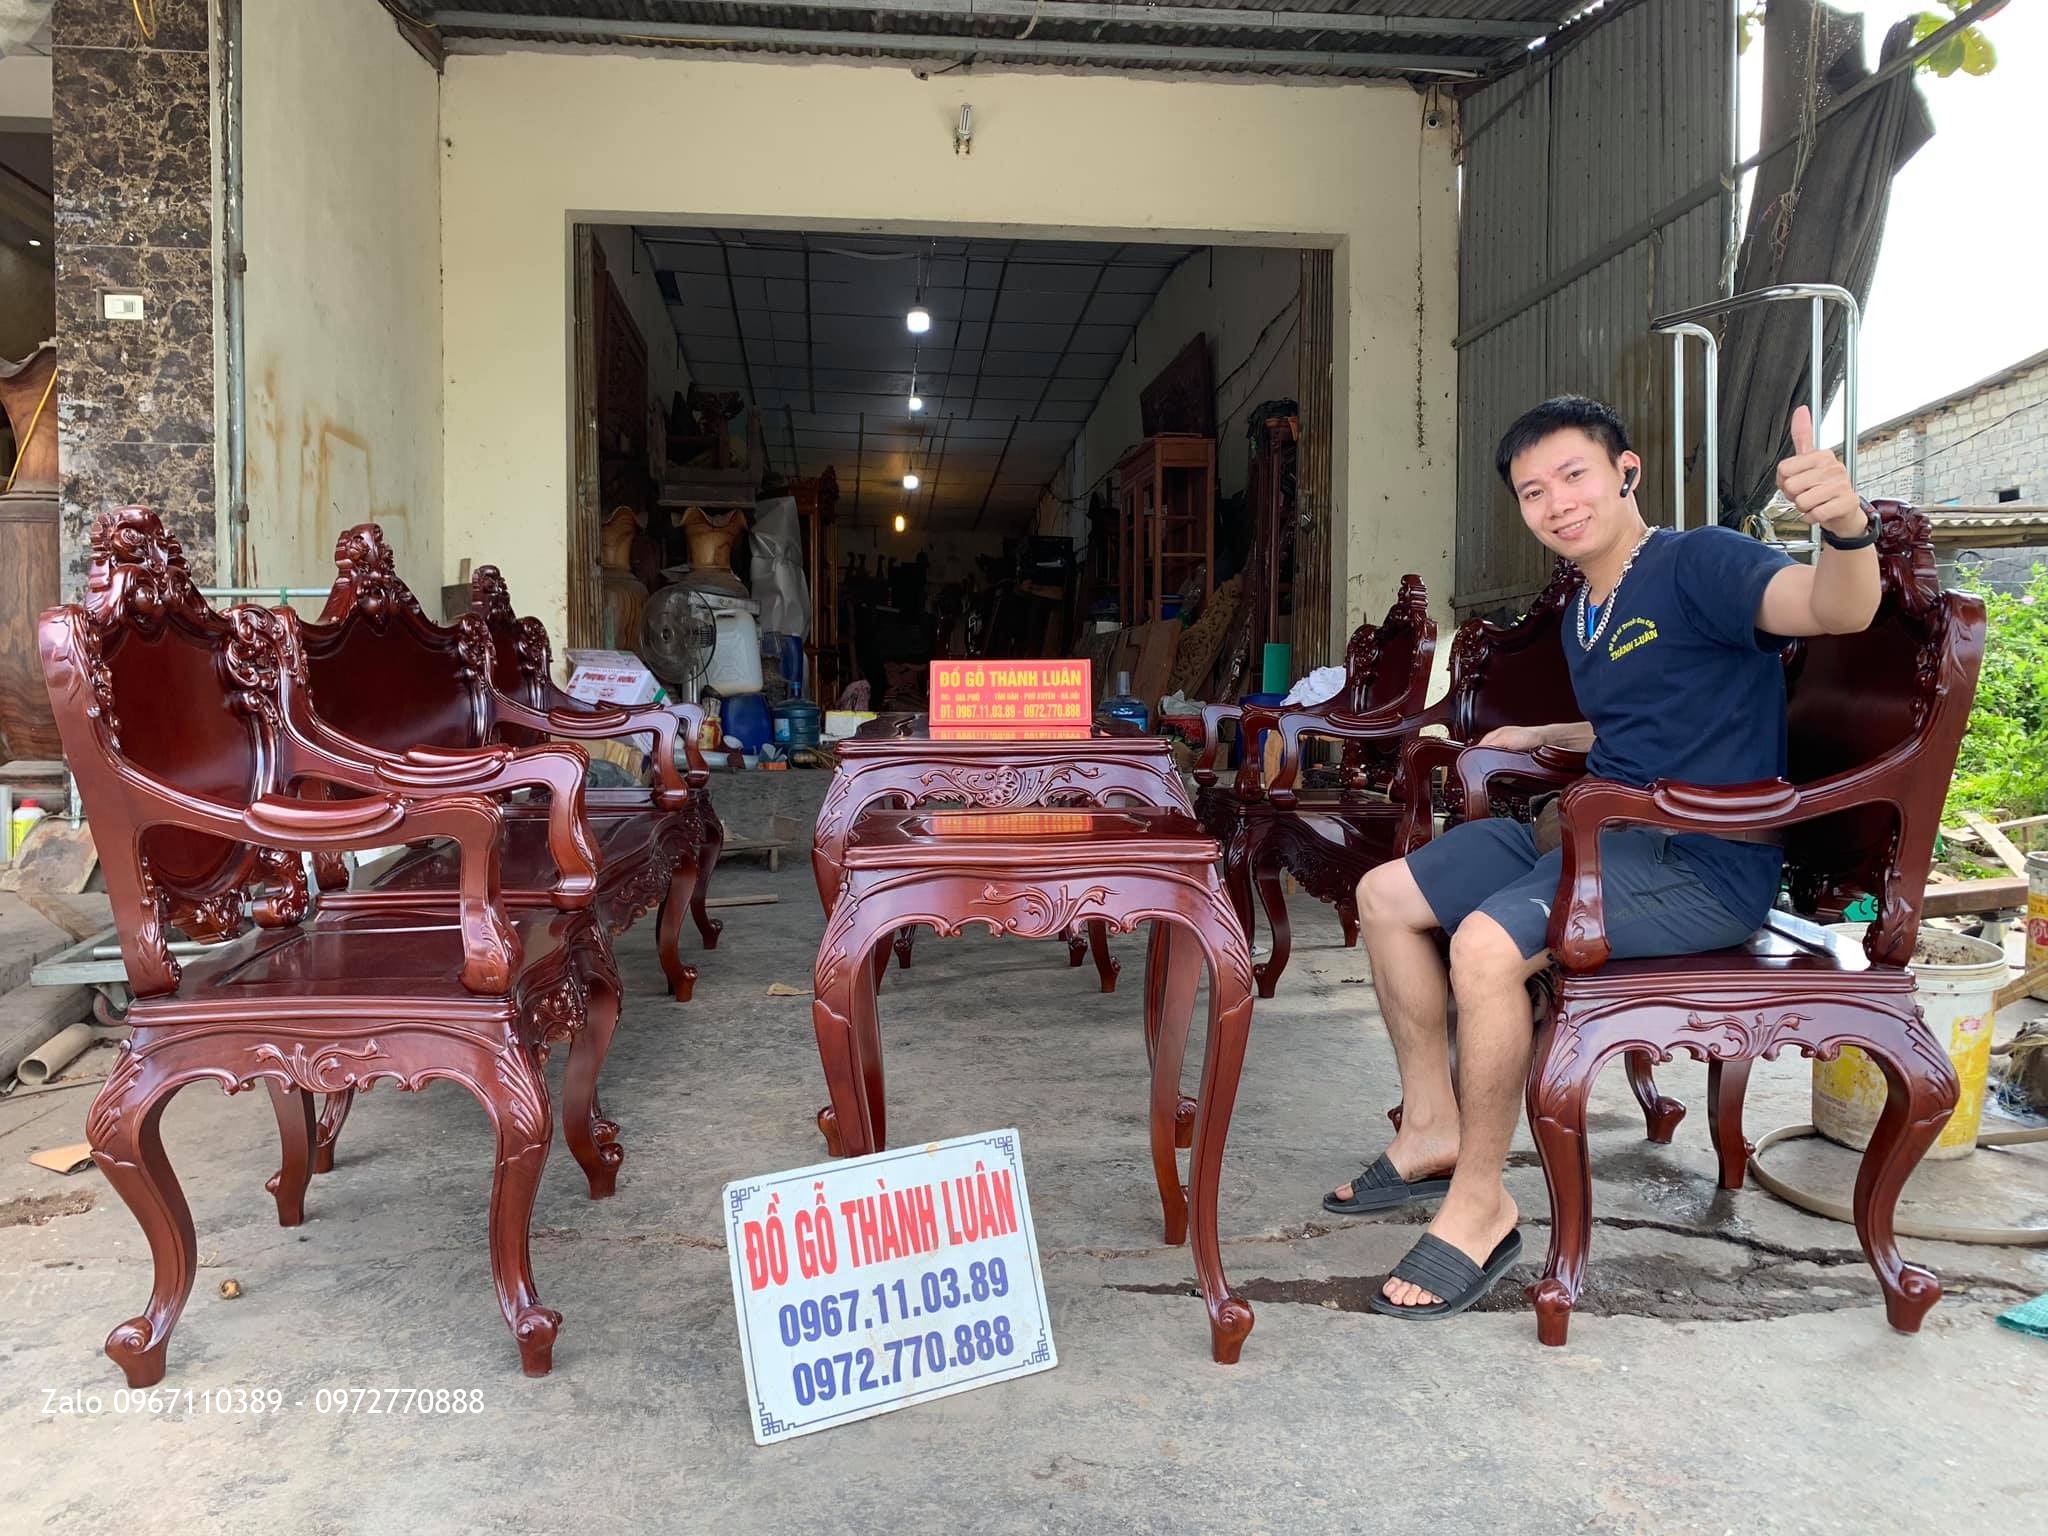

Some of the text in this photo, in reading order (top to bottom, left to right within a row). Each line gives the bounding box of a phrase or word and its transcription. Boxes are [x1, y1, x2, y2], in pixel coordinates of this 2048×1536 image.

[956, 704, 1016, 719] 0967.11.03.89
[1024, 703, 1081, 719] 0972.770.888
[965, 664, 985, 688] GỖ
[1042, 666, 1081, 687] LUÂN
[743, 1160, 1018, 1291] ĐỒ GỖ THÀNH LUÂN
[778, 1256, 1010, 1347] 0967.11.03.89
[792, 1315, 1014, 1406] 0972.770.888
